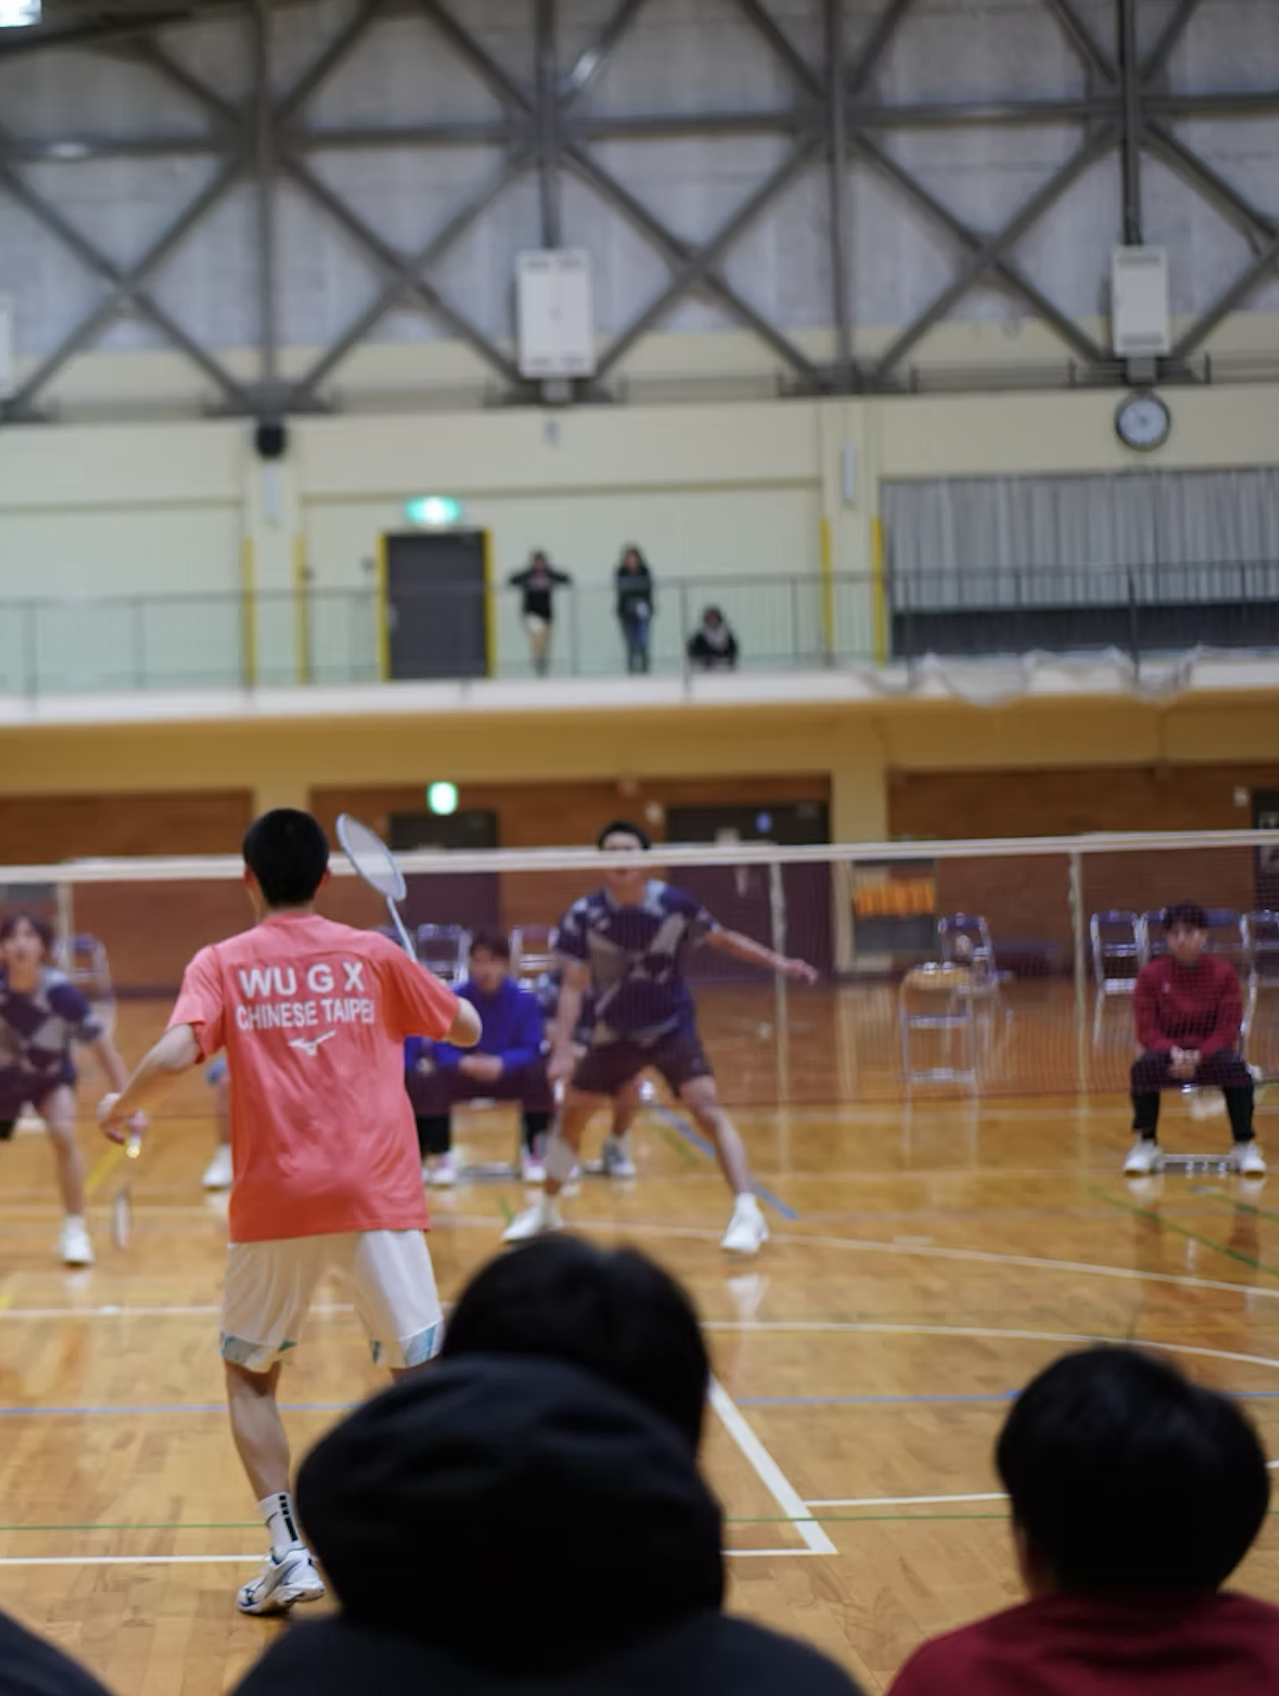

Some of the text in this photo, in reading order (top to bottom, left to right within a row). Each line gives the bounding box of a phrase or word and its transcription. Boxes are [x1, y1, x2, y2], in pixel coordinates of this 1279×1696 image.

[239, 962, 365, 998] WU G X
[236, 998, 375, 1030] CHINESE TAIPEI
